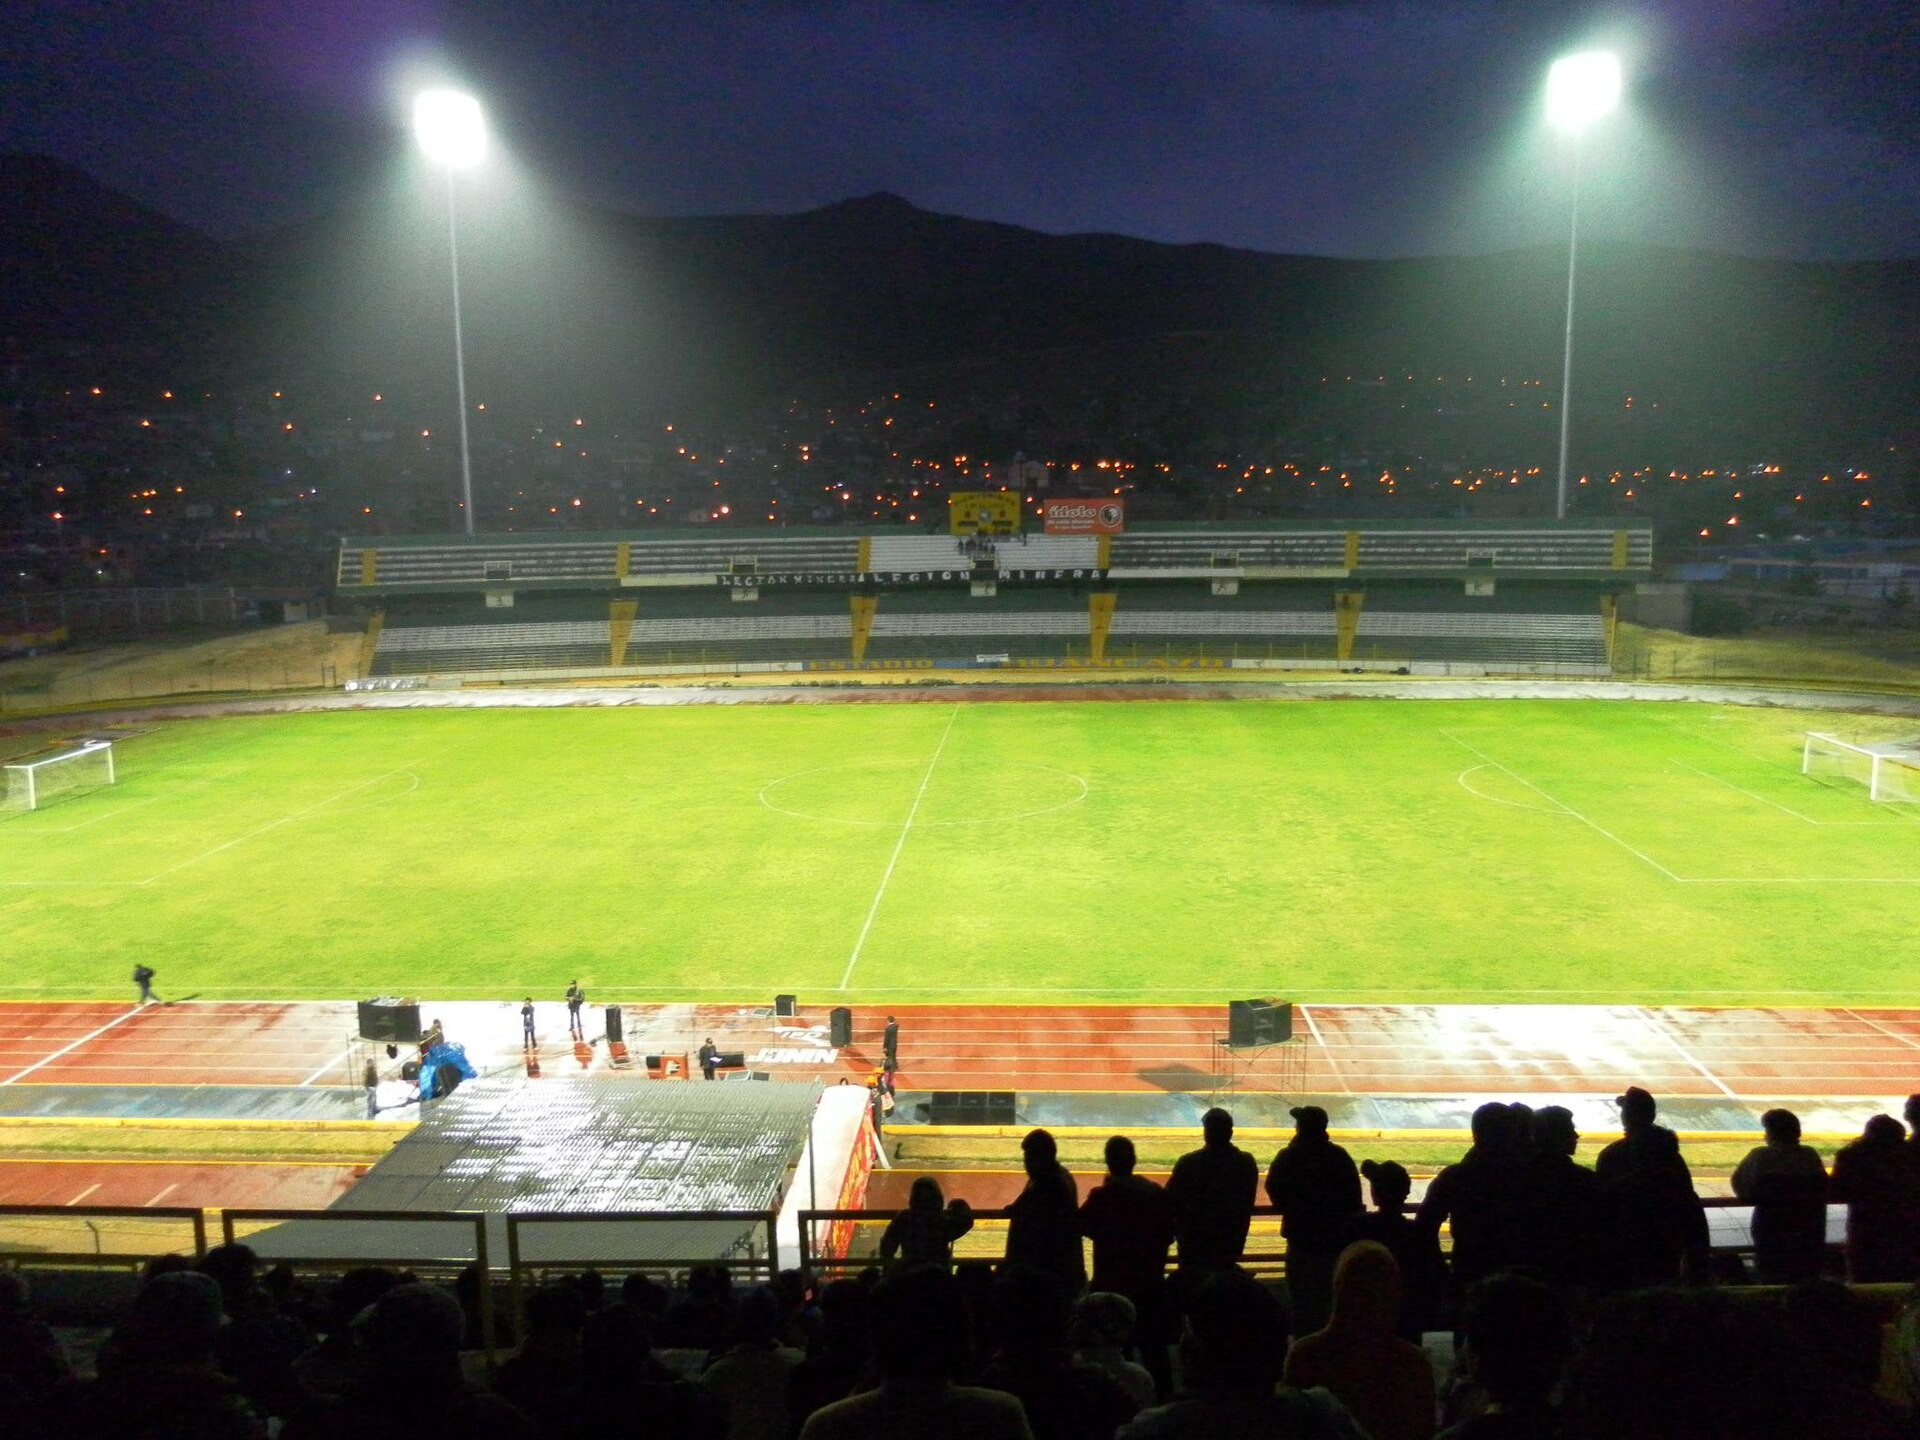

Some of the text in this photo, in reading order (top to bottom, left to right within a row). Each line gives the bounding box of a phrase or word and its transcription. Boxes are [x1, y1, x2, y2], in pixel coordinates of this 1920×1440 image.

[873, 569, 1100, 582] LEGION MINERA
[808, 659, 933, 669] ESTADIO
